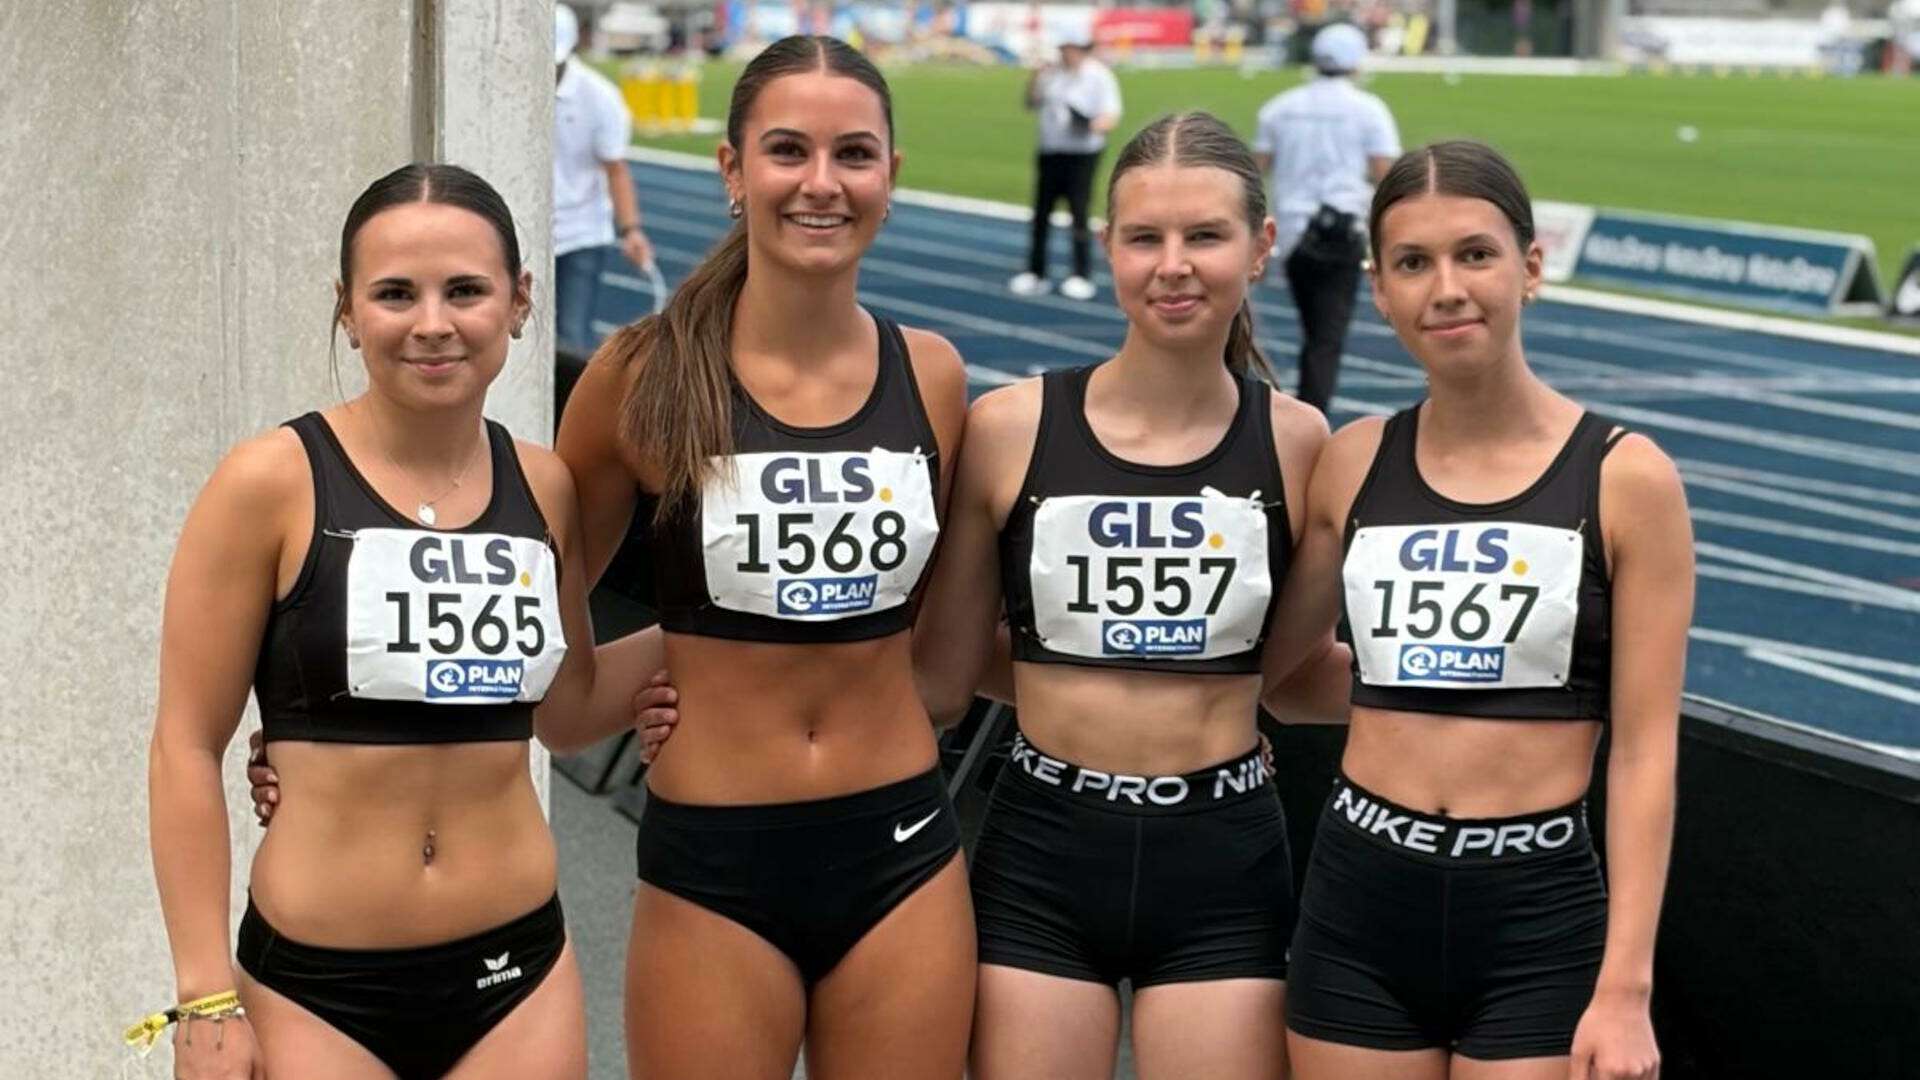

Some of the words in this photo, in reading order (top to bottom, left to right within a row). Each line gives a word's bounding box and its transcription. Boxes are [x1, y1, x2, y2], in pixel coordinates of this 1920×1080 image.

[735, 510, 908, 574] 1568
[821, 581, 874, 601] PLAN
[1066, 555, 1237, 616] 1557
[385, 591, 545, 657] 1565
[1145, 625, 1204, 643] PLAN
[1371, 580, 1540, 643] 1567
[468, 665, 521, 684] PLAN
[1440, 650, 1500, 670] PLAN
[1072, 768, 1189, 805] PRO
[1213, 755, 1270, 799] NIK
[1333, 787, 1446, 853] NIKE
[1450, 816, 1574, 857] PRO
[476, 966, 522, 989] erima
